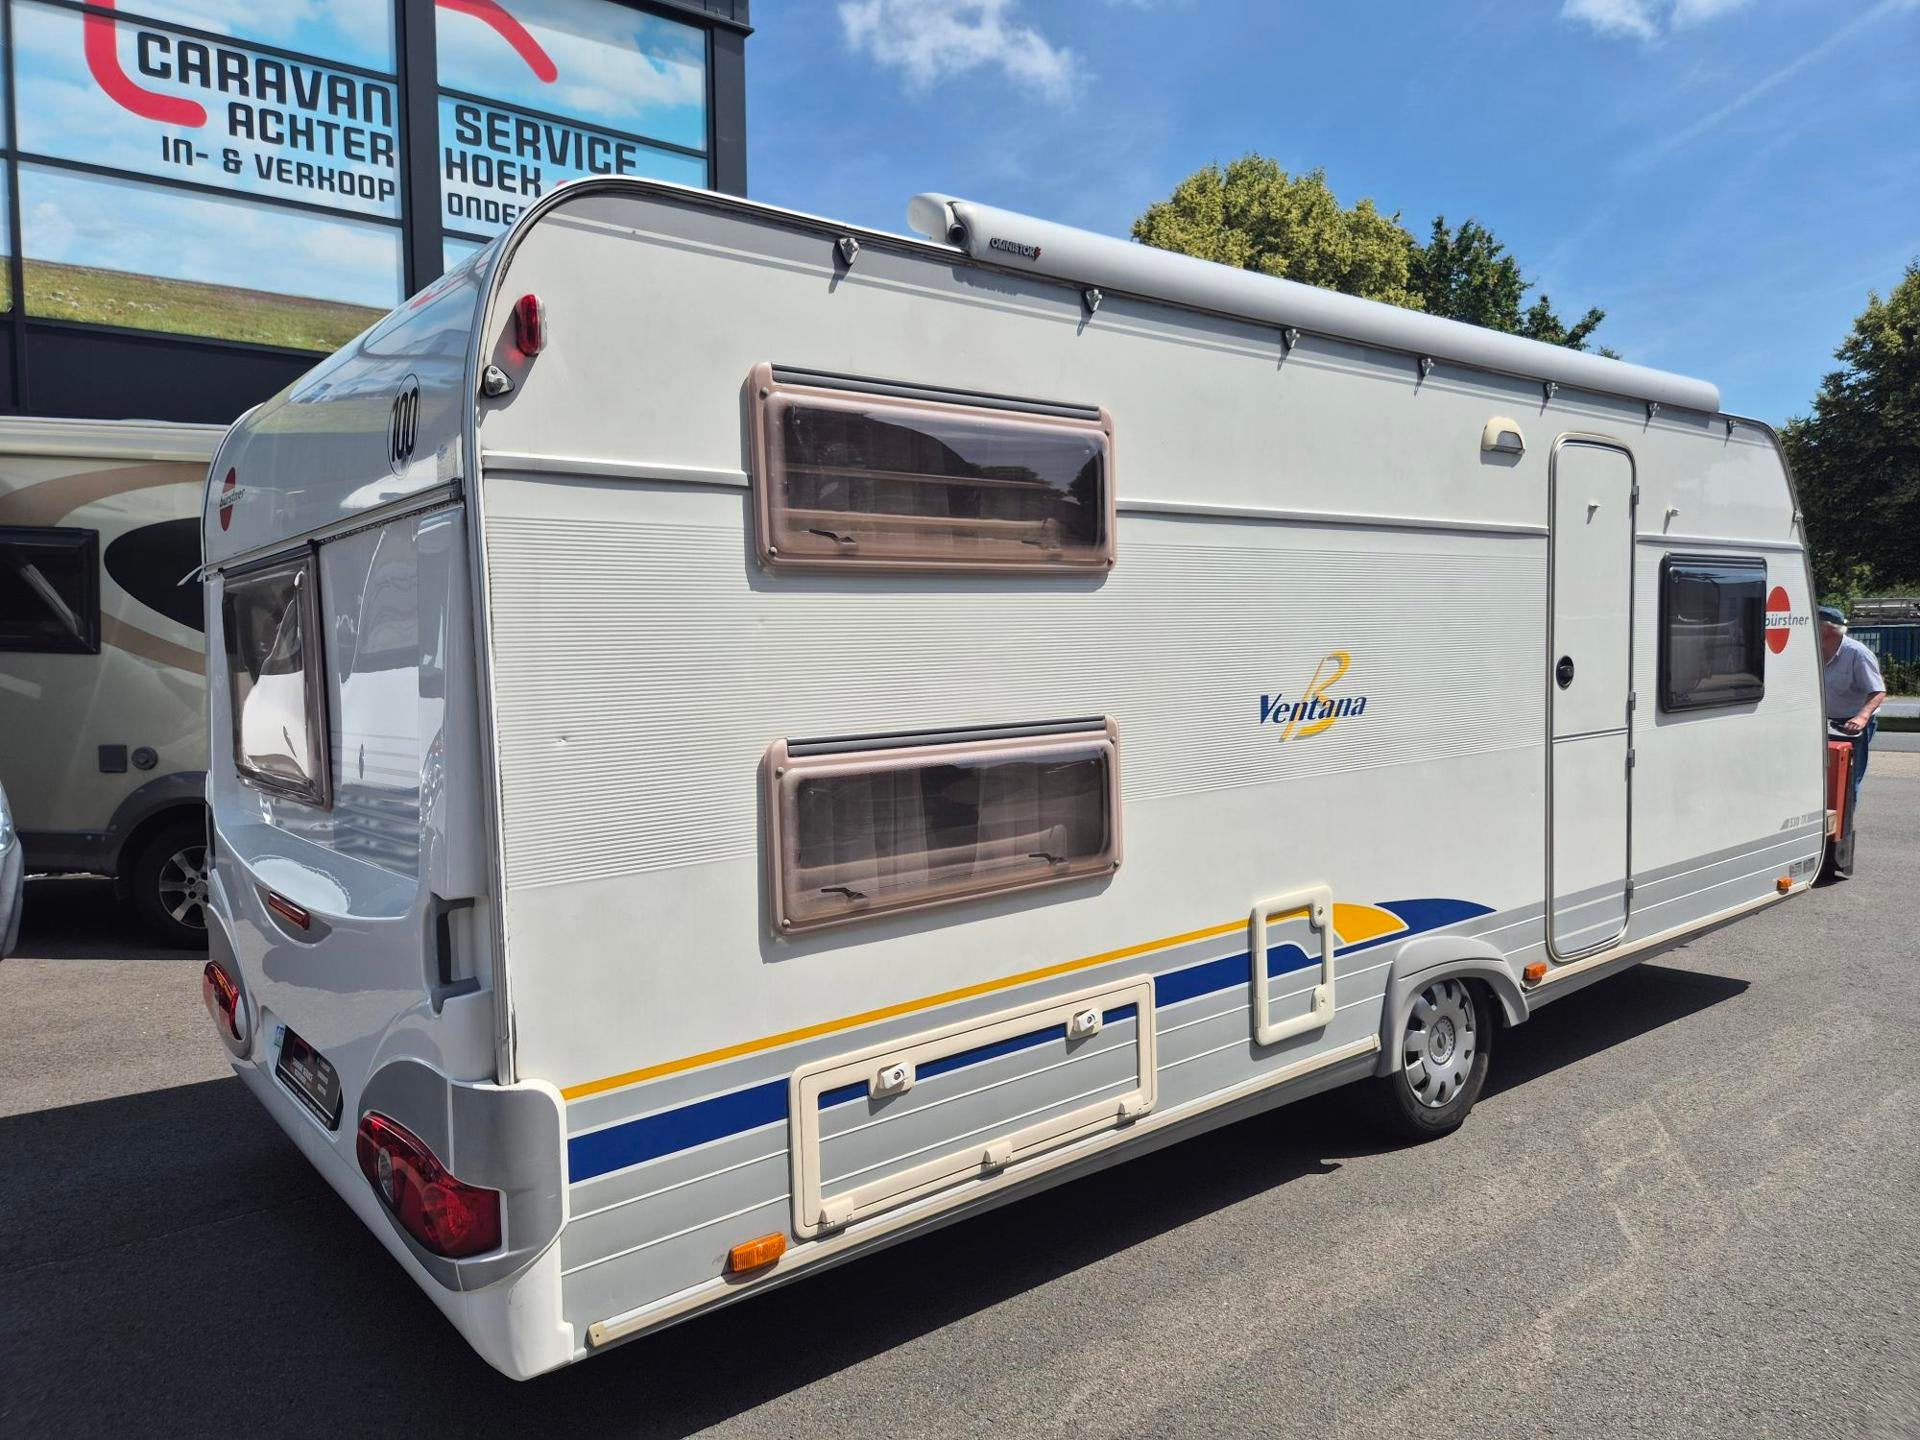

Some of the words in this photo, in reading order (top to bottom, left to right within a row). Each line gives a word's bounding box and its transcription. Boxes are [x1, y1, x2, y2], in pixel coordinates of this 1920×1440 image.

[137, 31, 392, 127] CARAVAN
[455, 104, 636, 175] SERVICE
[162, 136, 209, 166] IN-
[222, 148, 243, 174] &
[254, 153, 395, 202] VERKOOP
[447, 192, 528, 226] ONDE
[228, 102, 394, 168] ACHTER
[445, 147, 542, 198] HOEK
[1260, 693, 1367, 724] Ventana
